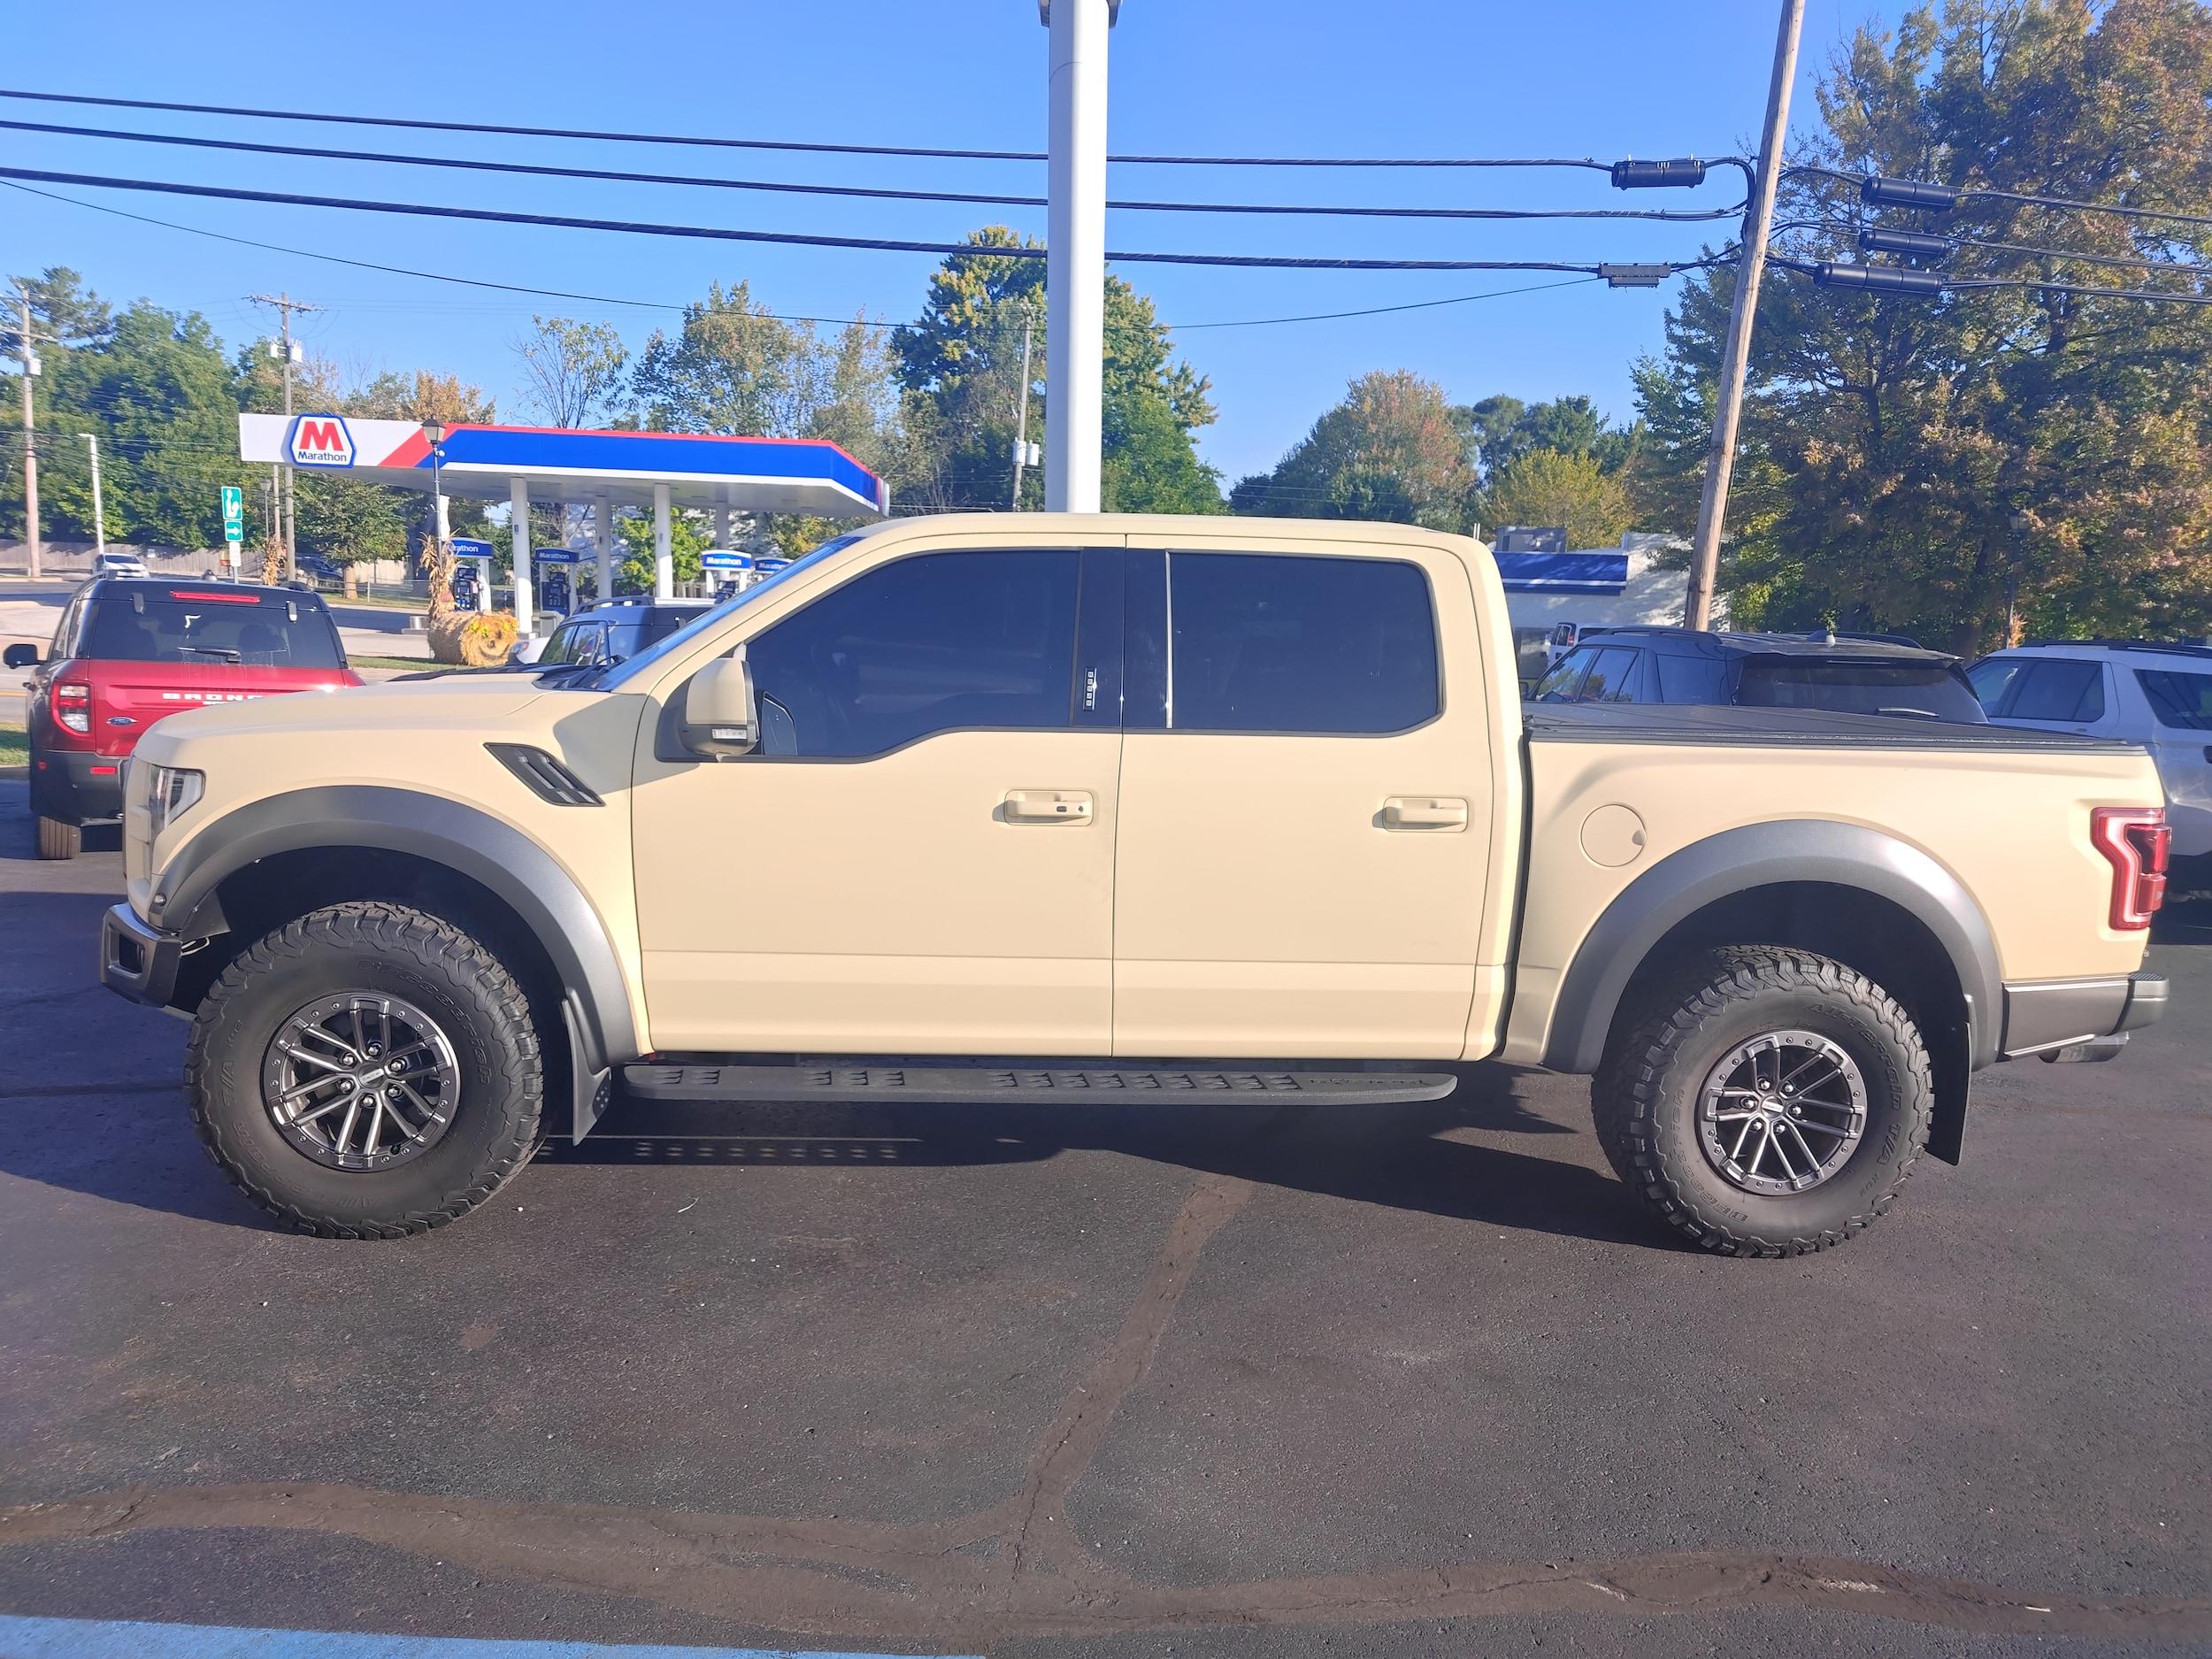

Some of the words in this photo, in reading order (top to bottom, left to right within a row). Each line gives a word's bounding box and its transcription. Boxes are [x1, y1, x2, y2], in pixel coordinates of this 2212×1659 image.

[297, 451, 347, 462] Marathon
[539, 551, 570, 560] Marathon
[706, 557, 742, 566] Marathon
[1669, 1088, 1750, 1224] BFGoodrich
